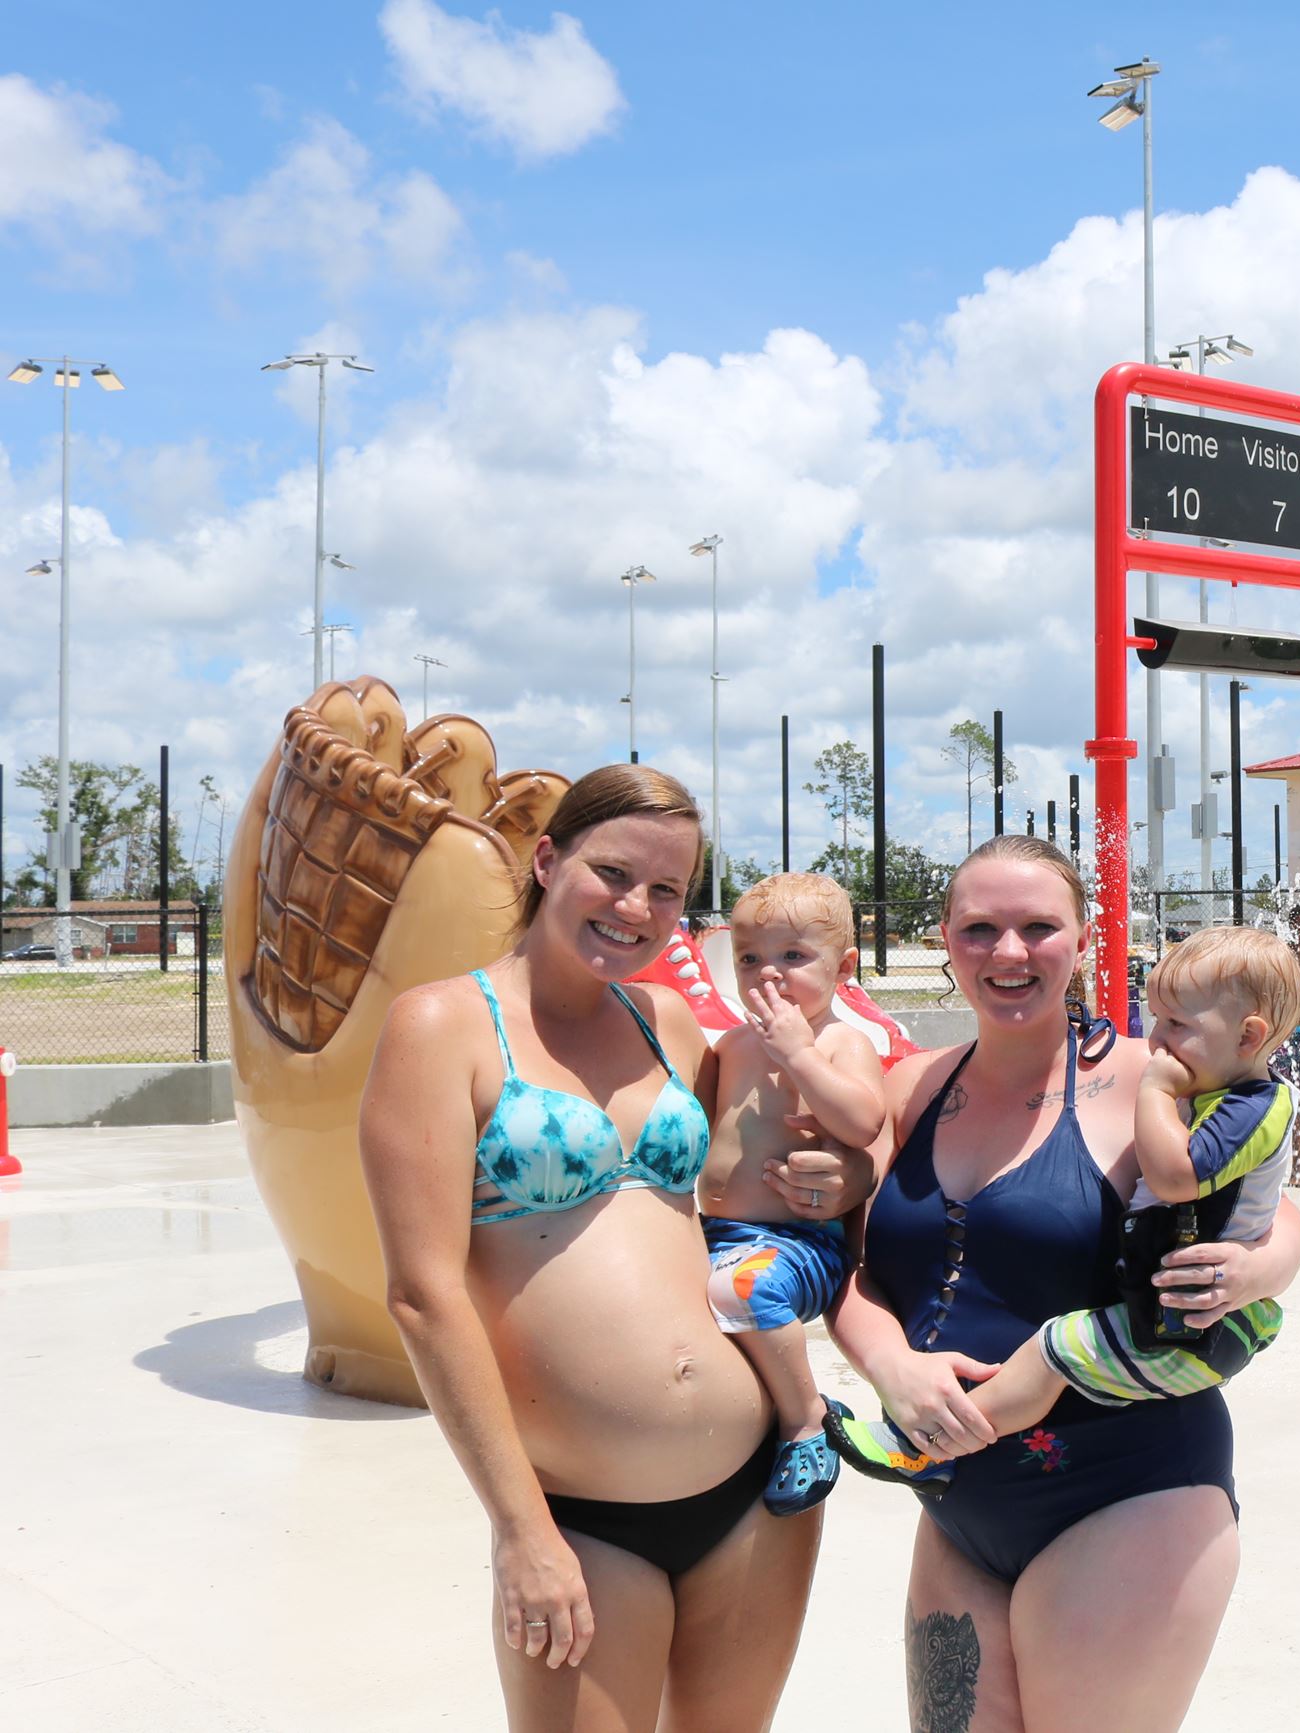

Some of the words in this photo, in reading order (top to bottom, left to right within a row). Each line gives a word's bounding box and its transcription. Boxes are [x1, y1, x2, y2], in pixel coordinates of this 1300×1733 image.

[1145, 421, 1219, 459] Home
[1167, 485, 1200, 521] 10
[1272, 500, 1287, 533] 7
